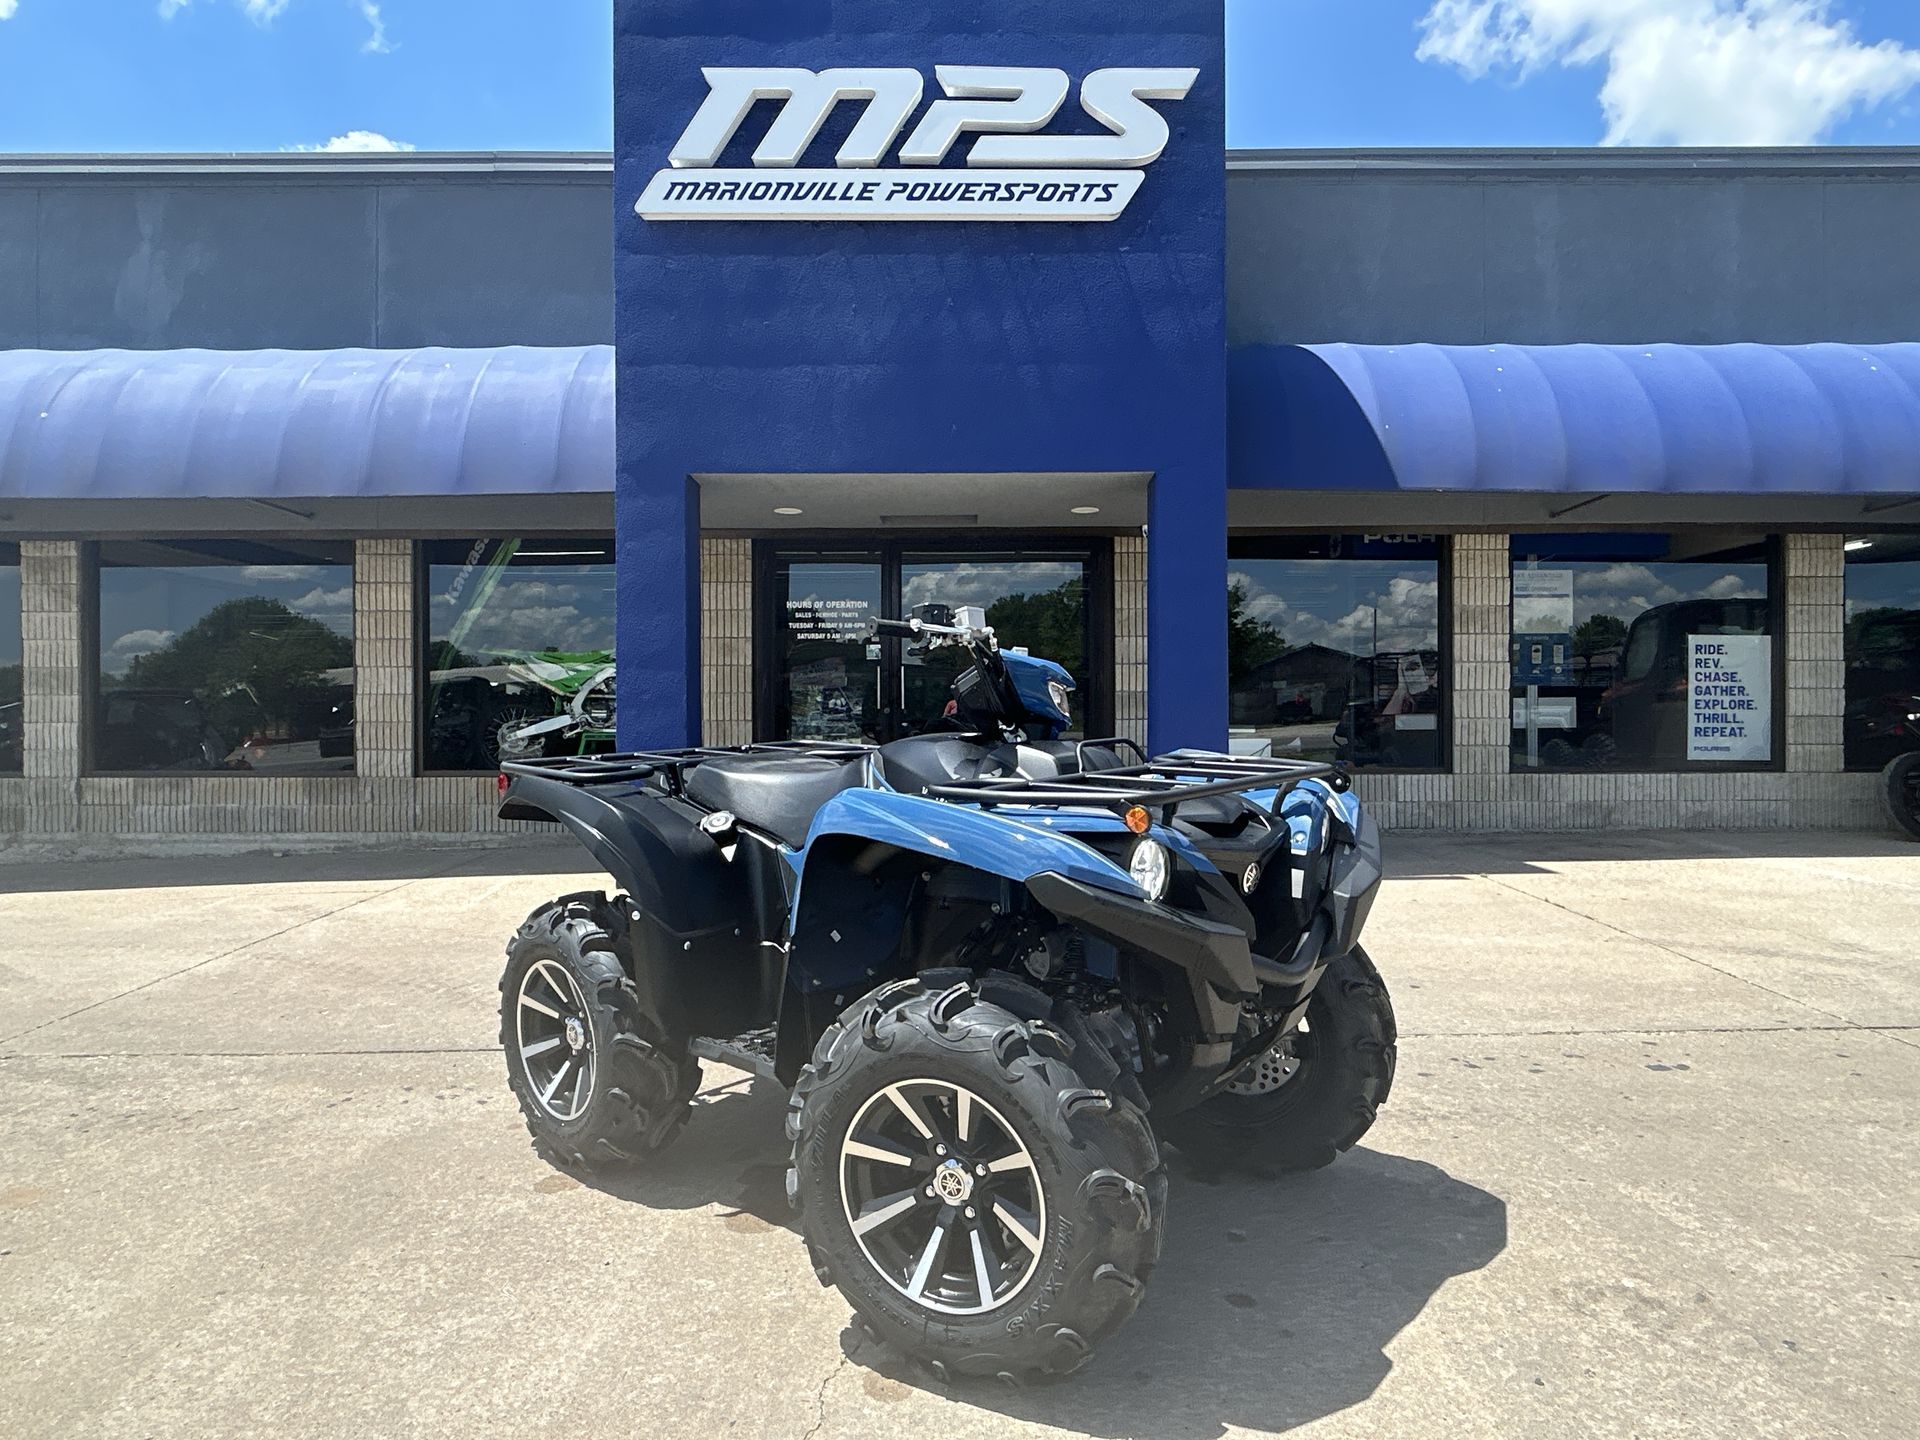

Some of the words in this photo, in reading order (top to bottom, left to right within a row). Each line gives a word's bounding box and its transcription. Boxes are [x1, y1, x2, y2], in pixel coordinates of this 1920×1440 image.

[668, 65, 1200, 168] MPS
[663, 182, 881, 200] MARIONVILLE
[885, 182, 1119, 202] POWERSPORTS
[786, 601, 812, 609] HOURS
[814, 601, 824, 609] OF
[826, 601, 868, 609] OPERATION
[1695, 644, 1728, 655] RIDE.
[1695, 658, 1724, 669] REV.
[1694, 671, 1742, 682] CHASE.
[1694, 685, 1749, 696] GATHER.
[1694, 699, 1758, 710] EXPLORE.
[1694, 713, 1744, 723] THRILL.
[1694, 726, 1747, 737] REPEAT.
[1006, 1214, 1073, 1338] MAXXIS
